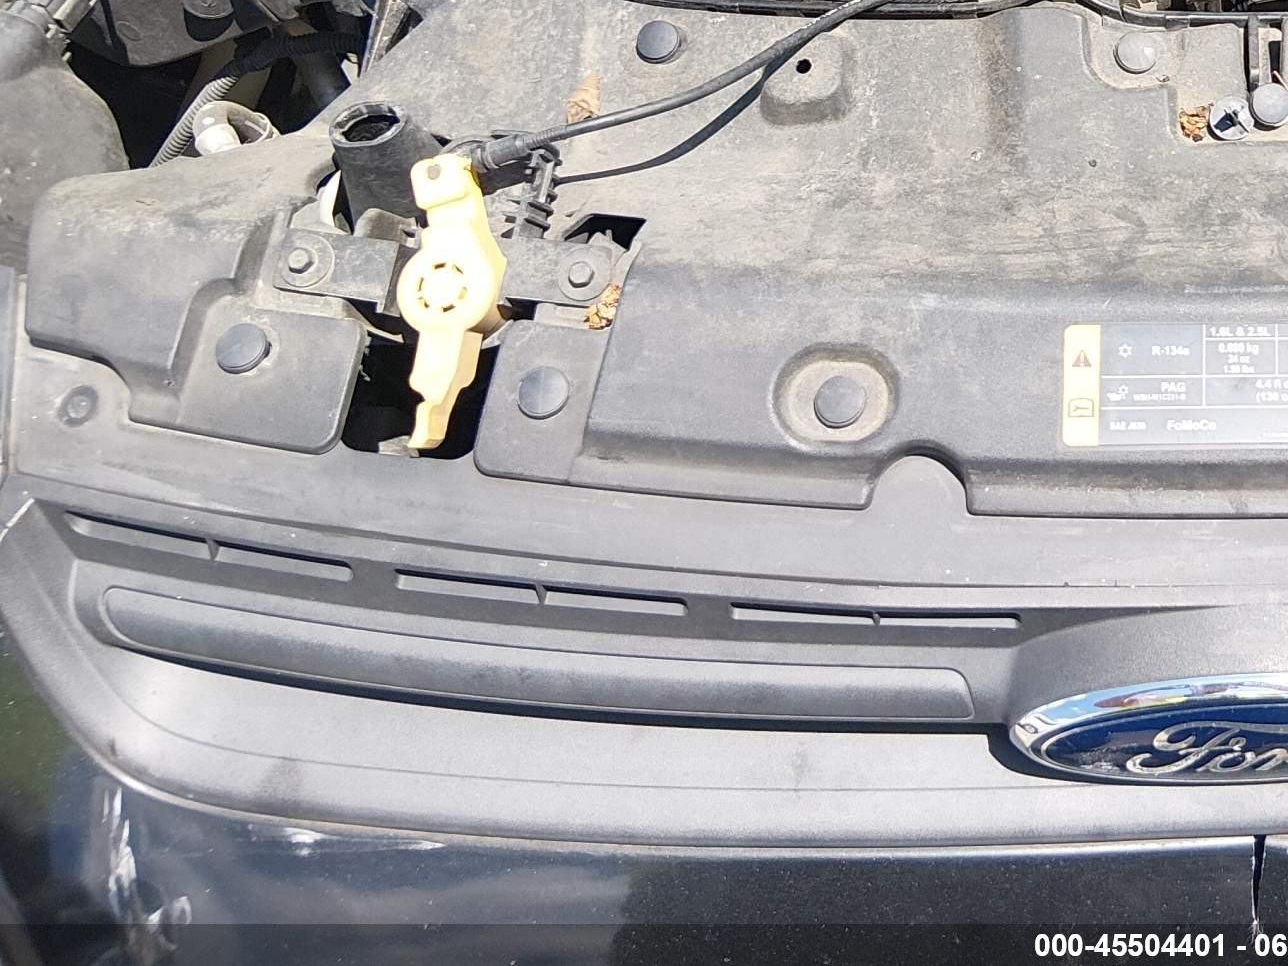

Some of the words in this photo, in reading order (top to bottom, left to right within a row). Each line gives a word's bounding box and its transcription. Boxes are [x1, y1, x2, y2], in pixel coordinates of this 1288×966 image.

[1151, 345, 1190, 356] R-134a
[1161, 382, 1187, 393] PAG
[1166, 419, 1217, 431] FoMoCo
